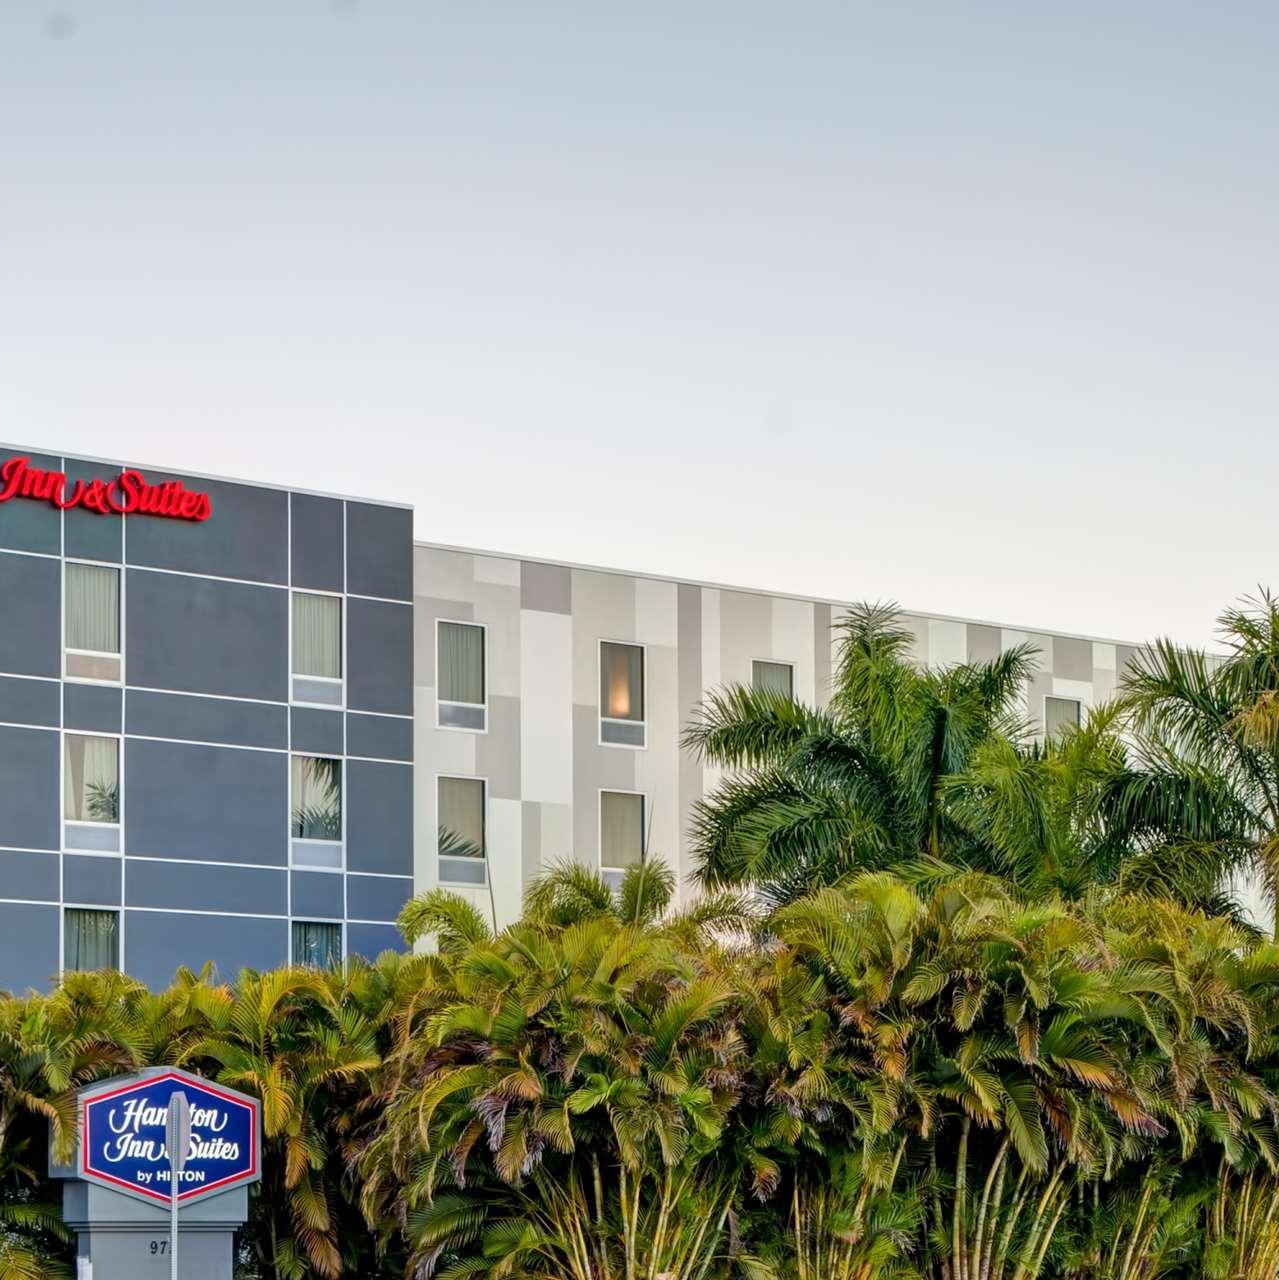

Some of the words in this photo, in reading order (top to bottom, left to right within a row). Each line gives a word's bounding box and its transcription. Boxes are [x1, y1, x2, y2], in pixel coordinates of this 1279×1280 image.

[81, 479, 110, 513] &
[106, 469, 212, 521] Suites
[109, 1098, 228, 1133] Hamton
[104, 1133, 165, 1162] Inn
[185, 1133, 239, 1160] Suites
[137, 1170, 152, 1183] by
[156, 1170, 205, 1181] HITON
[150, 1240, 172, 1255] 97
